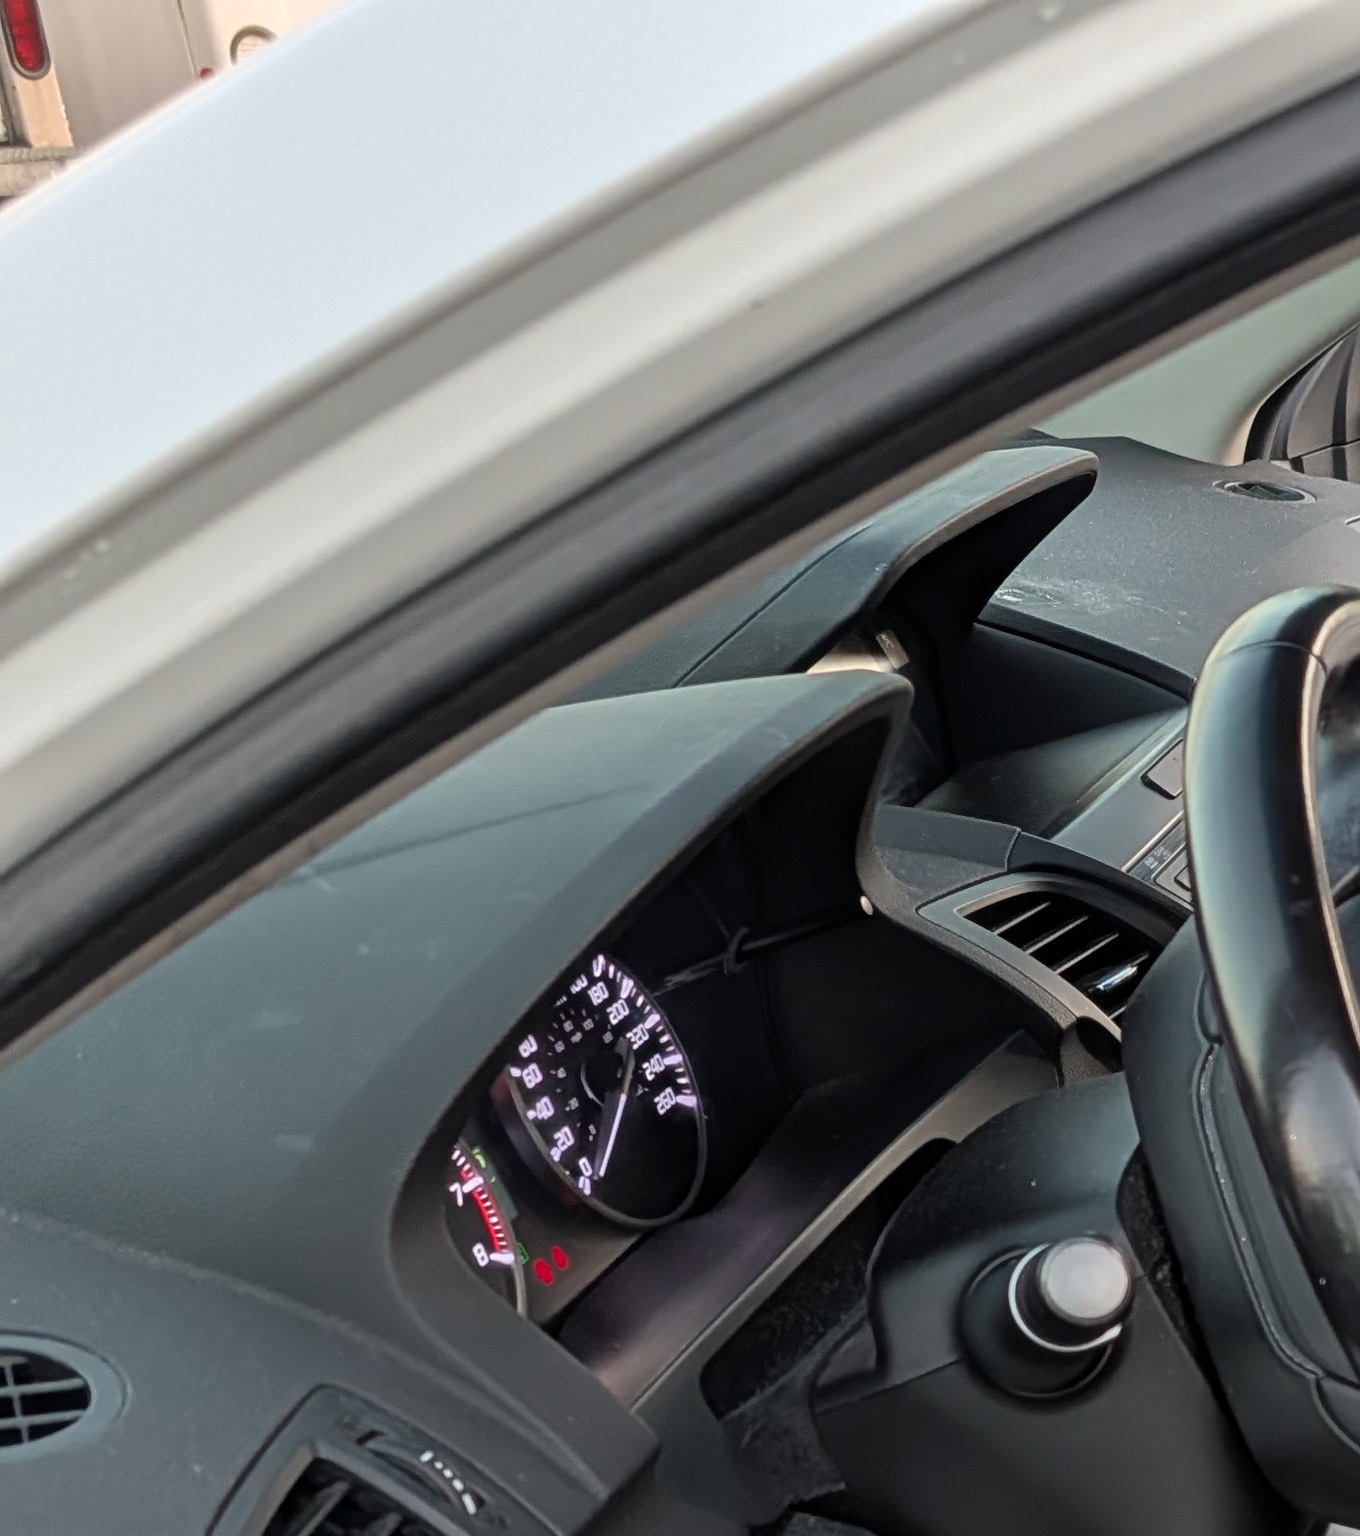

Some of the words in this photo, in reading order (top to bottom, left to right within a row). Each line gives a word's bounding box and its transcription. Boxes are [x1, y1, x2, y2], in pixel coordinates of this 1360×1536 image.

[588, 981, 609, 1006] 180
[606, 999, 629, 1025] 200
[522, 1062, 543, 1089] 60
[642, 1053, 665, 1081] 240
[535, 1096, 555, 1120] 40
[653, 1086, 677, 1115] 260
[553, 1126, 574, 1151] 20
[578, 1156, 592, 1177] 0
[448, 1182, 463, 1207] 7
[472, 1242, 489, 1267] 8
